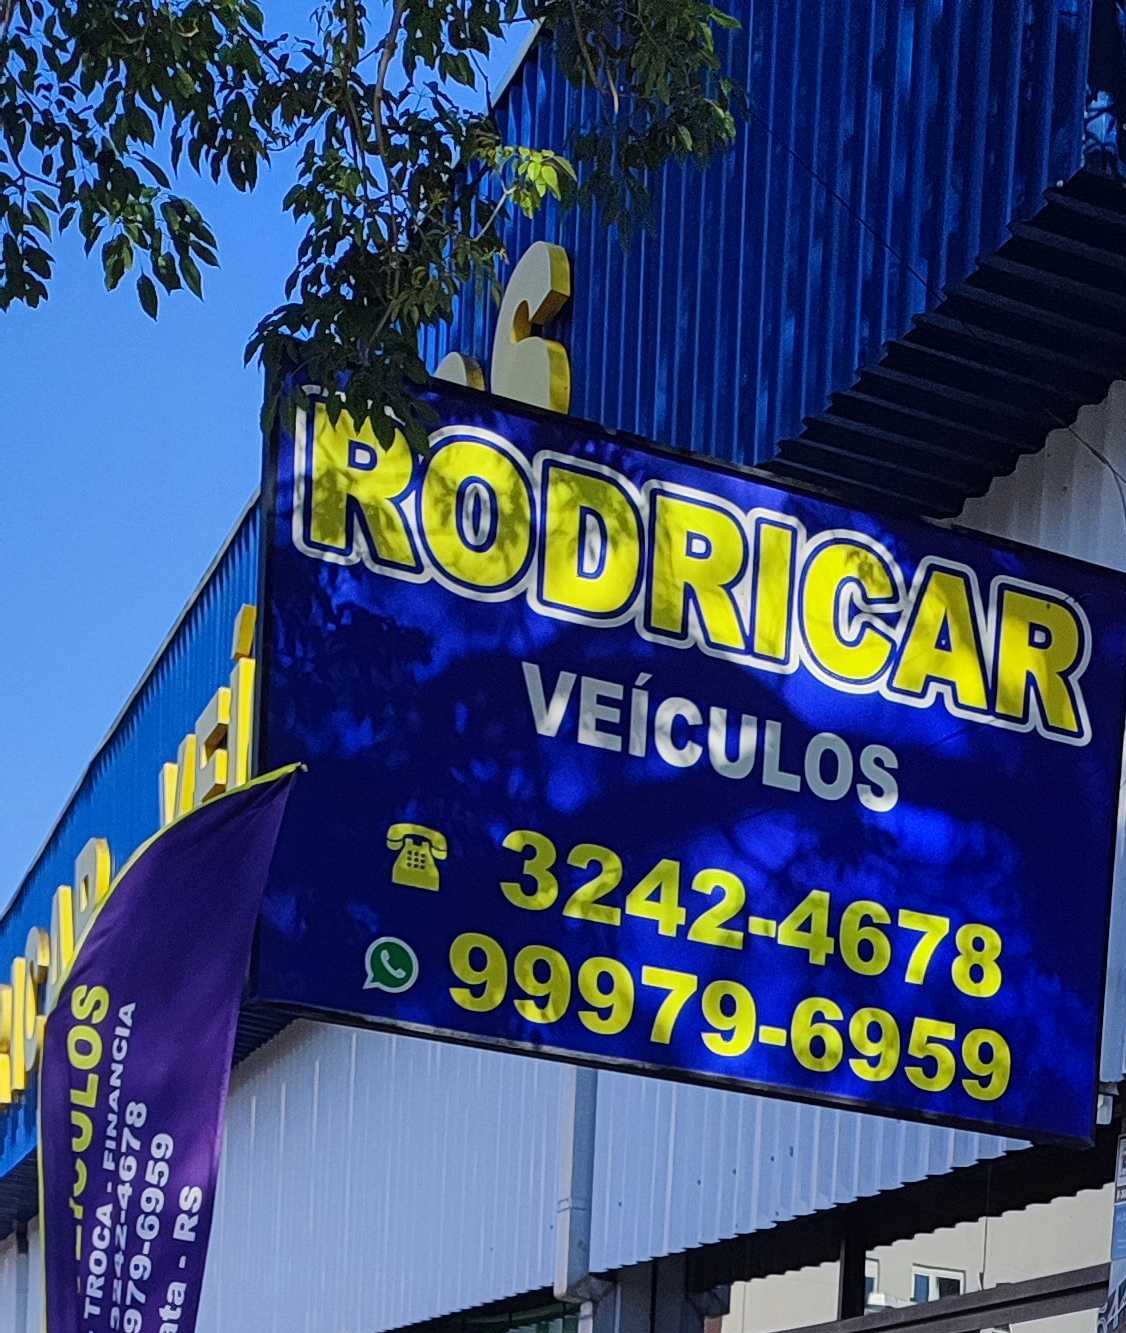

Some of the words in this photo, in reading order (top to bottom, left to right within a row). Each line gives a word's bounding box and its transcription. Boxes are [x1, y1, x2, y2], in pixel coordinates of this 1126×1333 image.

[293, 392, 1090, 742] RODRICAR
[522, 661, 899, 812] VEÍCULOS
[500, 829, 1003, 998] 3242-4678
[448, 932, 1011, 1101] 99979-6959
[84, 1202, 113, 1320] TROCA
[102, 1002, 137, 1171] FINANCIA
[173, 1185, 203, 1242] RS
